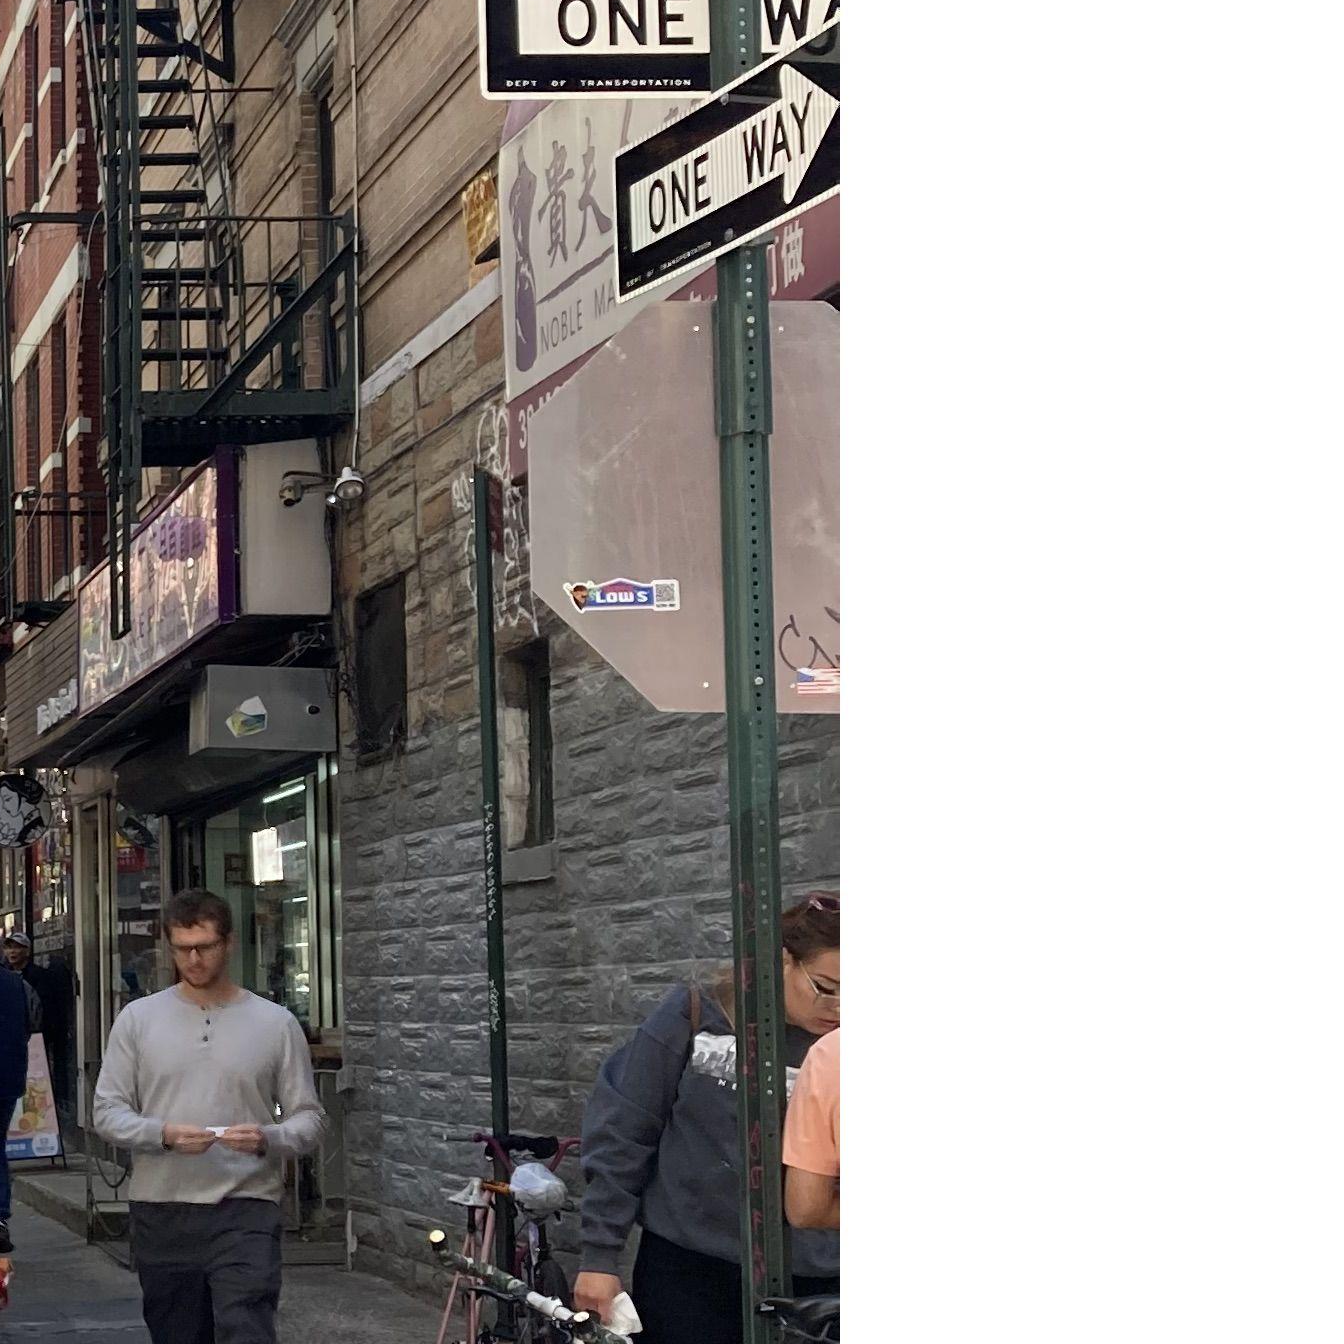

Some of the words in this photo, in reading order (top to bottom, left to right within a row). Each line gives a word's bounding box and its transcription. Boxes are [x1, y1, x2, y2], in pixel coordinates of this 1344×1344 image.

[505, 79, 538, 88] DEPT
[551, 79, 566, 88] OF
[581, 78, 692, 88] TRANSPORTATION
[648, 150, 713, 235] ONE
[742, 92, 813, 185] WAY
[540, 299, 584, 356] NOBLE
